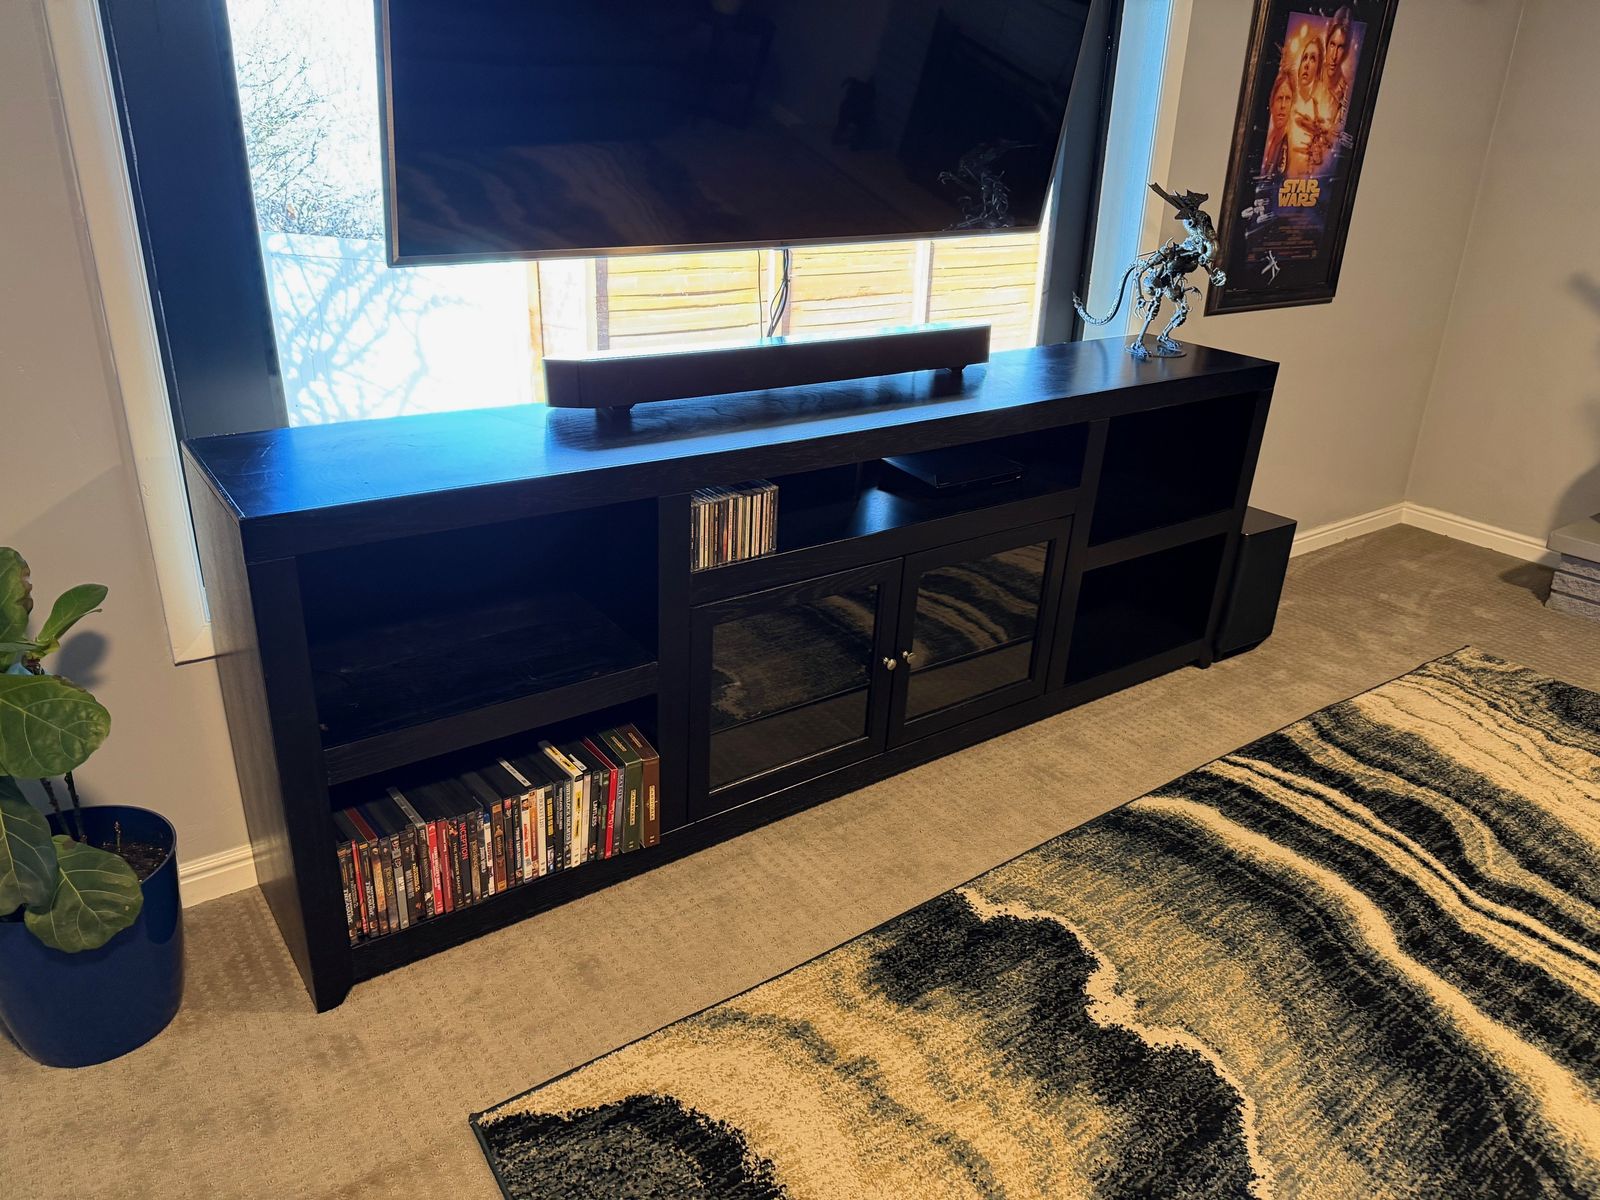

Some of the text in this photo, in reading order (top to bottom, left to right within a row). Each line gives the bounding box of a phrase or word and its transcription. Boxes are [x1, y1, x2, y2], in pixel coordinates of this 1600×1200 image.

[1279, 179, 1320, 193] STAR
[1278, 192, 1320, 207] WARS
[460, 822, 469, 860] INCEPTION
